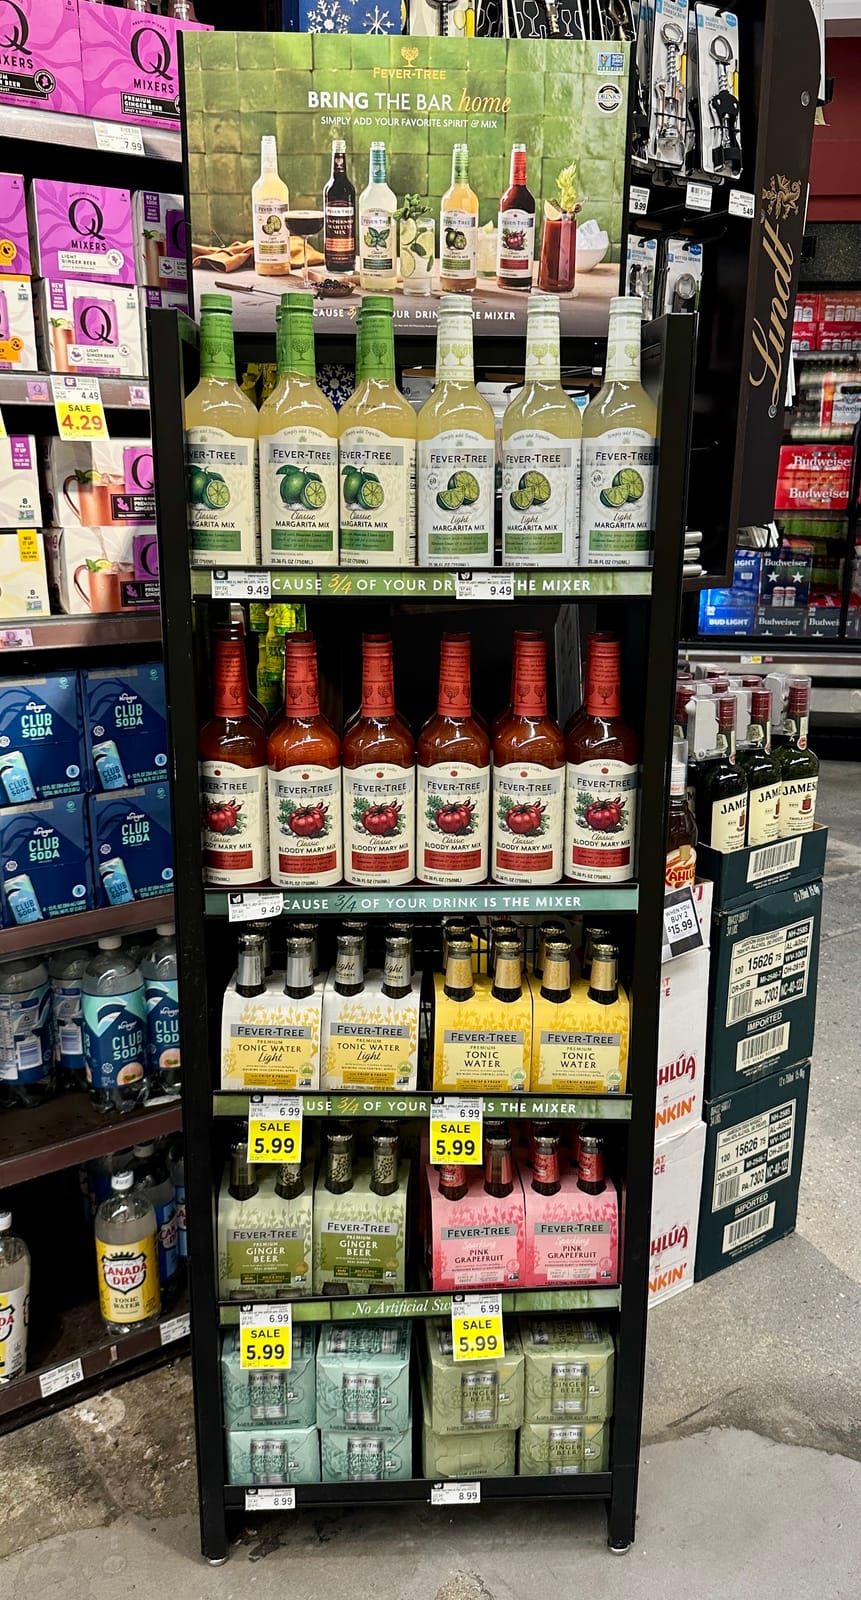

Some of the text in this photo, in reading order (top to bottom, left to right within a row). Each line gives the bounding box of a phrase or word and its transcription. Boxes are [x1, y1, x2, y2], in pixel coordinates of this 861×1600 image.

[0, 54, 34, 70] IXERS
[373, 67, 447, 80] FEVER-TREE
[133, 78, 175, 94] MIXERS
[308, 87, 512, 113] BRING THE BAR home
[321, 116, 497, 128] SIMPLY ADD YOUR FAVORITE SPIRIT & MIX
[124, 141, 142, 151] 7.99
[634, 201, 646, 211] 9.99
[68, 198, 106, 240] Q
[312, 308, 344, 318] CAUSE
[415, 311, 440, 319] DRIN
[470, 312, 481, 320] HE
[484, 311, 516, 320] MIXER
[749, 218, 794, 406] Lindt
[79, 305, 114, 344] Q
[61, 414, 103, 430] 4.29
[273, 448, 331, 460] FEVER-TREE
[340, 450, 392, 460] FEVER-TREE
[430, 454, 488, 464] FEVER-TREE
[506, 454, 561, 464] FEVER-TREE
[595, 451, 653, 461] FEVER-TREE
[793, 456, 851, 468] Budweise
[195, 510, 218, 521] Classic
[350, 510, 372, 521] Classic
[594, 521, 648, 529] MARGARITA MIX
[764, 558, 808, 567] Budweiser
[246, 585, 269, 595] 9.49
[272, 574, 591, 595] CAUSE 3/4 OF YOUR DRI HE MIXER
[490, 585, 512, 595] 9.49
[758, 618, 801, 627] Budweiser
[119, 693, 138, 704] Kroger
[114, 703, 143, 719] CLUB
[21, 713, 52, 729] CLUB
[115, 716, 144, 728] SODA
[21, 726, 53, 738] SODA
[279, 783, 333, 794] FEVER-TREE
[353, 782, 407, 793] FEVER-TREE
[427, 780, 481, 791] FEVER-TREE
[499, 780, 552, 792] FEVER-TREE
[577, 777, 632, 788] FEVER-TREE
[782, 781, 816, 796] JAMES
[720, 797, 746, 815] JAME
[121, 821, 150, 837] CLUB
[28, 837, 60, 853] CLUB
[122, 833, 151, 845] SODA
[573, 838, 599, 847] BLOODY
[600, 840, 619, 848] MARY
[351, 844, 376, 852] BLOODY
[378, 843, 398, 851] MARY
[424, 841, 449, 850] BLOODY
[450, 843, 470, 851] MARY
[28, 850, 61, 862] SODA
[15, 900, 35, 912] CLUB
[282, 894, 582, 913] CAUSE 3/4 OF YOUR DRINK IS THE MIXER
[665, 903, 691, 918] WHEN YOU
[670, 911, 689, 924] BUY 2
[667, 919, 693, 936] $15.99
[747, 952, 782, 972] 15626 75
[735, 965, 744, 975] 120
[754, 986, 779, 1007] PA-7303
[746, 1010, 783, 1032] IMPORTED
[237, 1026, 305, 1037] FEVER-TREE
[337, 1025, 403, 1036] FEVER-TREE
[112, 1030, 143, 1050] CLUB
[451, 1032, 517, 1043] FEVER-TREE
[547, 1033, 614, 1044] FEVER-TREE
[238, 1044, 302, 1053] TONIC WATER
[337, 1042, 400, 1052] TONIC WATER
[465, 1051, 499, 1060] TONIC
[562, 1052, 595, 1061] TONIC
[657, 1053, 697, 1087] HLÚA
[336, 1097, 359, 1115] 3/4
[363, 1101, 382, 1111] OF
[387, 1102, 428, 1112] YOUR
[483, 1102, 495, 1112] IS
[500, 1102, 527, 1112] THE
[531, 1103, 577, 1113] MIXER
[259, 1122, 291, 1132] SALE
[440, 1124, 471, 1134] SALE
[769, 1130, 791, 1145] WV-1001
[254, 1138, 295, 1154] 5.99
[436, 1139, 475, 1156] 5.99
[735, 1136, 766, 1158] 15626 75
[720, 1152, 731, 1163] 120
[734, 1194, 769, 1216] IMPORTED
[327, 1222, 391, 1233] FEVER-TREE
[447, 1226, 511, 1238] FEVER-TREE
[541, 1224, 604, 1233] FEVER-TREE
[233, 1230, 298, 1240] FEVER-TREE
[246, 1246, 286, 1255] GINGER
[339, 1240, 378, 1249] GINGER
[454, 1255, 504, 1264] GRAPEFRUIT
[102, 1262, 148, 1276] CANADA
[114, 1296, 138, 1304] TONIC
[352, 1299, 428, 1316] No Artificial
[463, 1320, 492, 1330] SALE
[250, 1329, 281, 1339] SALE
[459, 1335, 498, 1352] 5.99
[246, 1344, 285, 1360] 5.99
[64, 1371, 81, 1385] 2.59
[552, 1381, 586, 1389] GINGER
[273, 1497, 293, 1506] 8.99
[459, 1491, 478, 1500] 8.99
